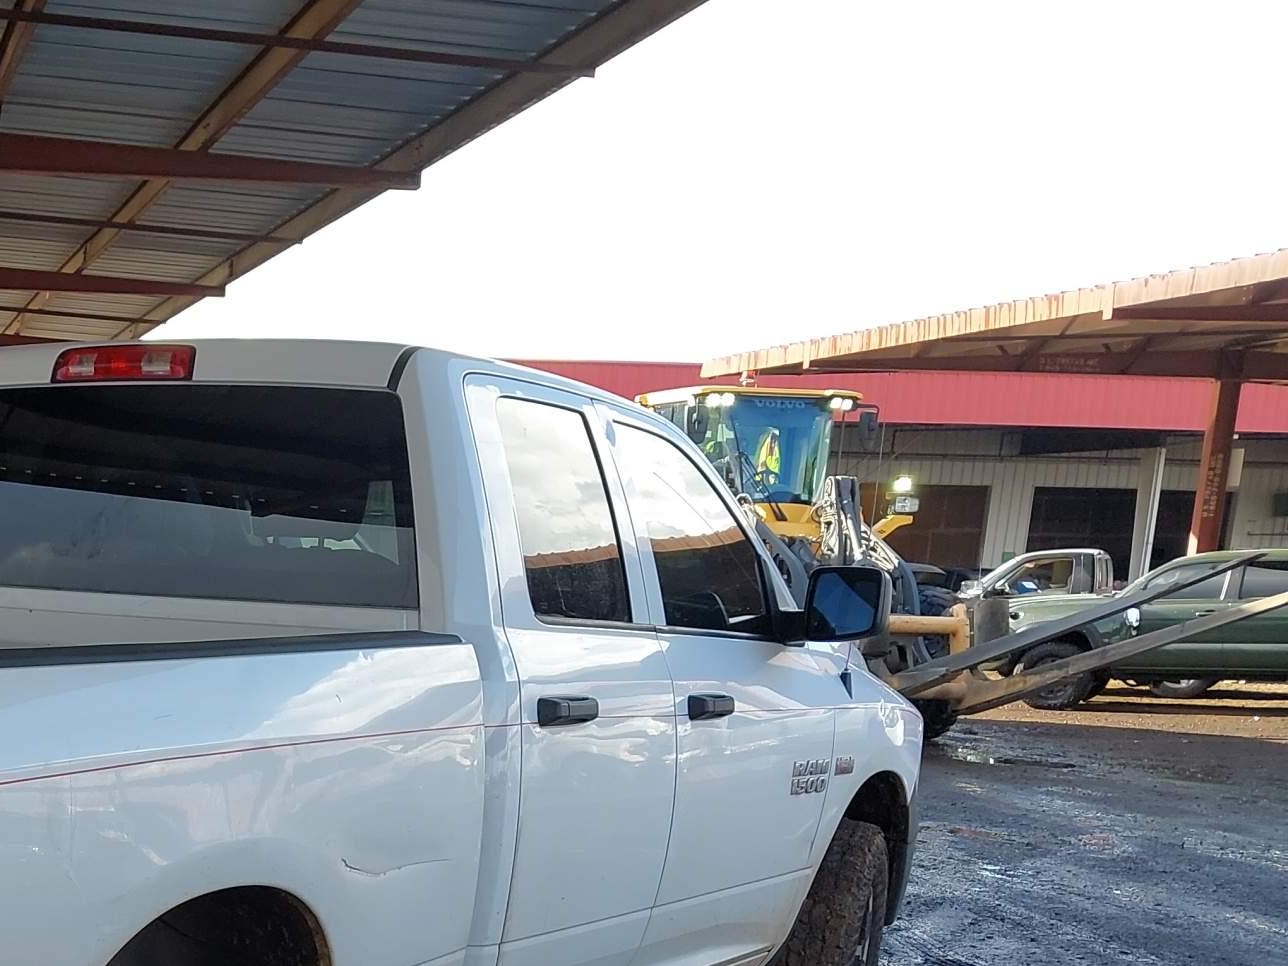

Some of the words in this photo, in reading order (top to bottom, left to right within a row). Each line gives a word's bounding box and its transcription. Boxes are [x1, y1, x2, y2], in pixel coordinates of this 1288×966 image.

[754, 399, 805, 409] VOLVO
[792, 758, 830, 777] RAM
[790, 776, 827, 795] 1500
